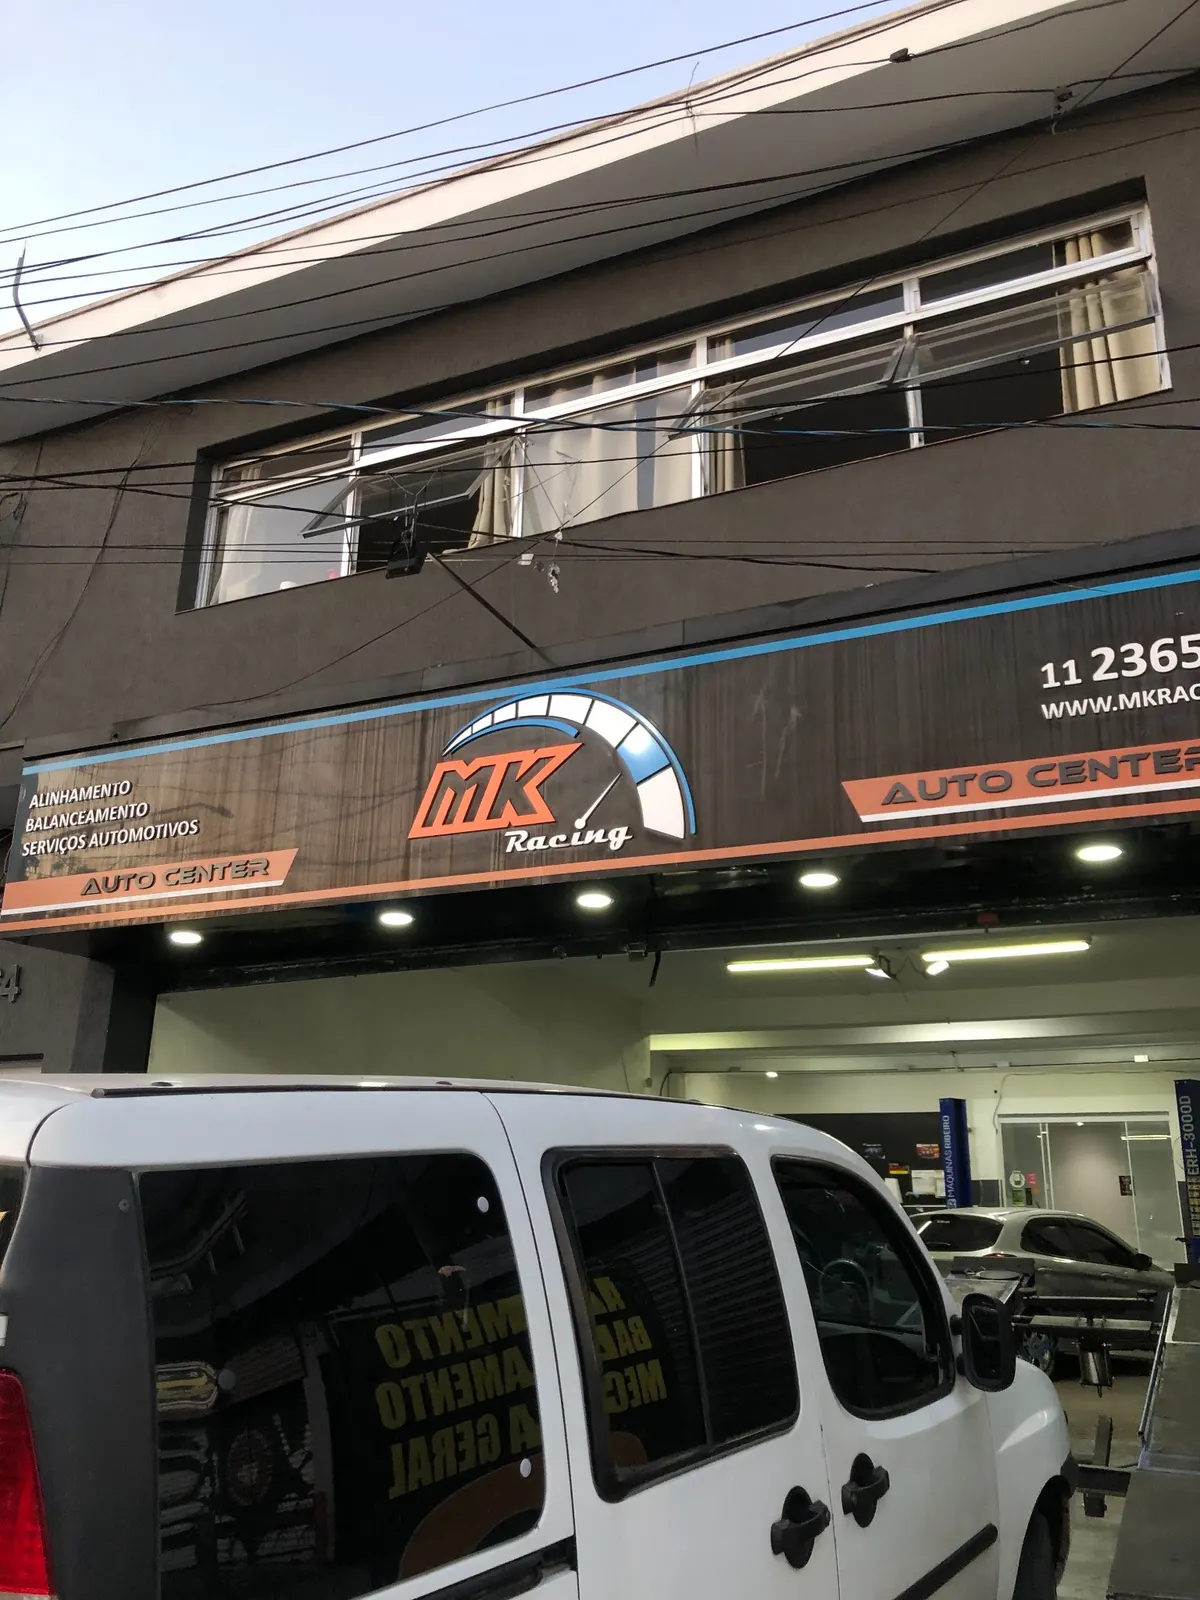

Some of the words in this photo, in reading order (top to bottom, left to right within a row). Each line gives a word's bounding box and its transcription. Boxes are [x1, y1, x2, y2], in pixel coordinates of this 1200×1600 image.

[1040, 659, 1083, 689] 11
[1091, 633, 1200, 681] 2365
[28, 780, 132, 809] ALINHAMENTO
[408, 742, 584, 840] MK
[881, 770, 1013, 806] AUTO
[25, 802, 149, 832] BALANCEAMENTO
[21, 834, 86, 857] SERVIÇOS
[88, 819, 200, 848] AUTOMOTIVOS
[504, 825, 634, 853] Racing
[80, 871, 155, 896] AUTO
[163, 858, 270, 887] CENTER
[942, 1115, 952, 1149] RIBEIRO
[1179, 1095, 1199, 1175] ERH-3000D
